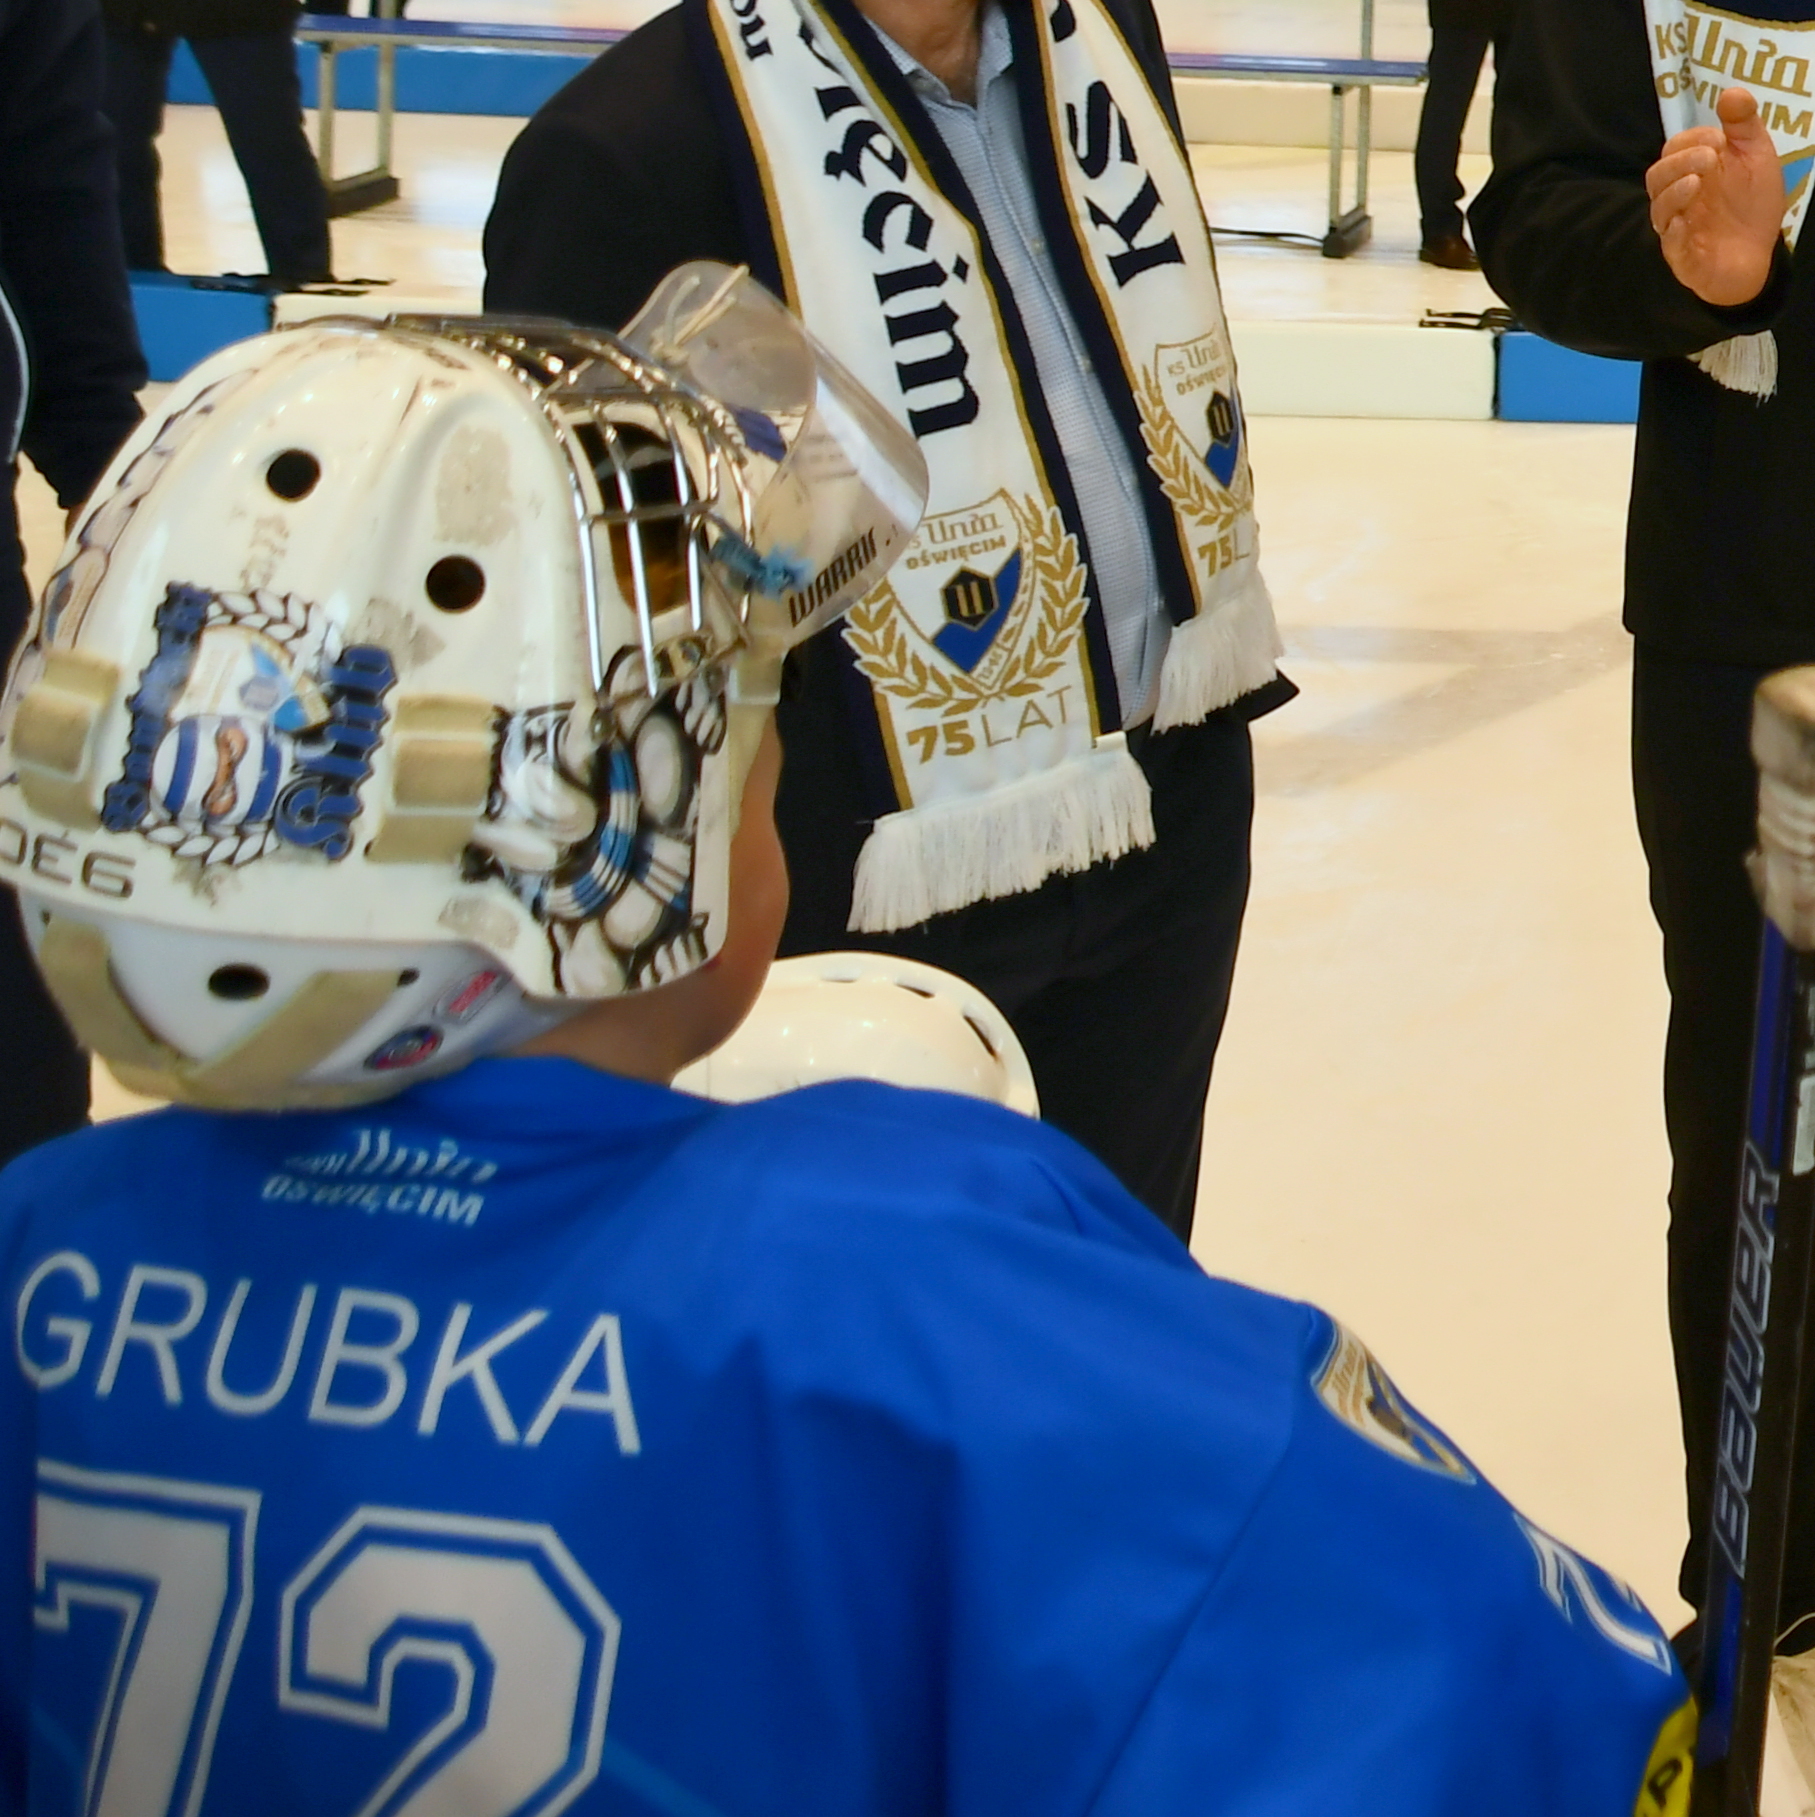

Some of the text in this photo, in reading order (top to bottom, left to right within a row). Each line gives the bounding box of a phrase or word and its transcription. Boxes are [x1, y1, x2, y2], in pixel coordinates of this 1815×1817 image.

[1684, 11, 1812, 99] Unia
[906, 534, 1006, 570] OŚWIĘCIM
[1198, 537, 1233, 578] 75
[906, 687, 1071, 764] 75 LAT
[17, 1251, 641, 1455] GRUBKA
[1713, 1139, 1780, 1580] BAUER
[35, 1458, 620, 1817] 72
